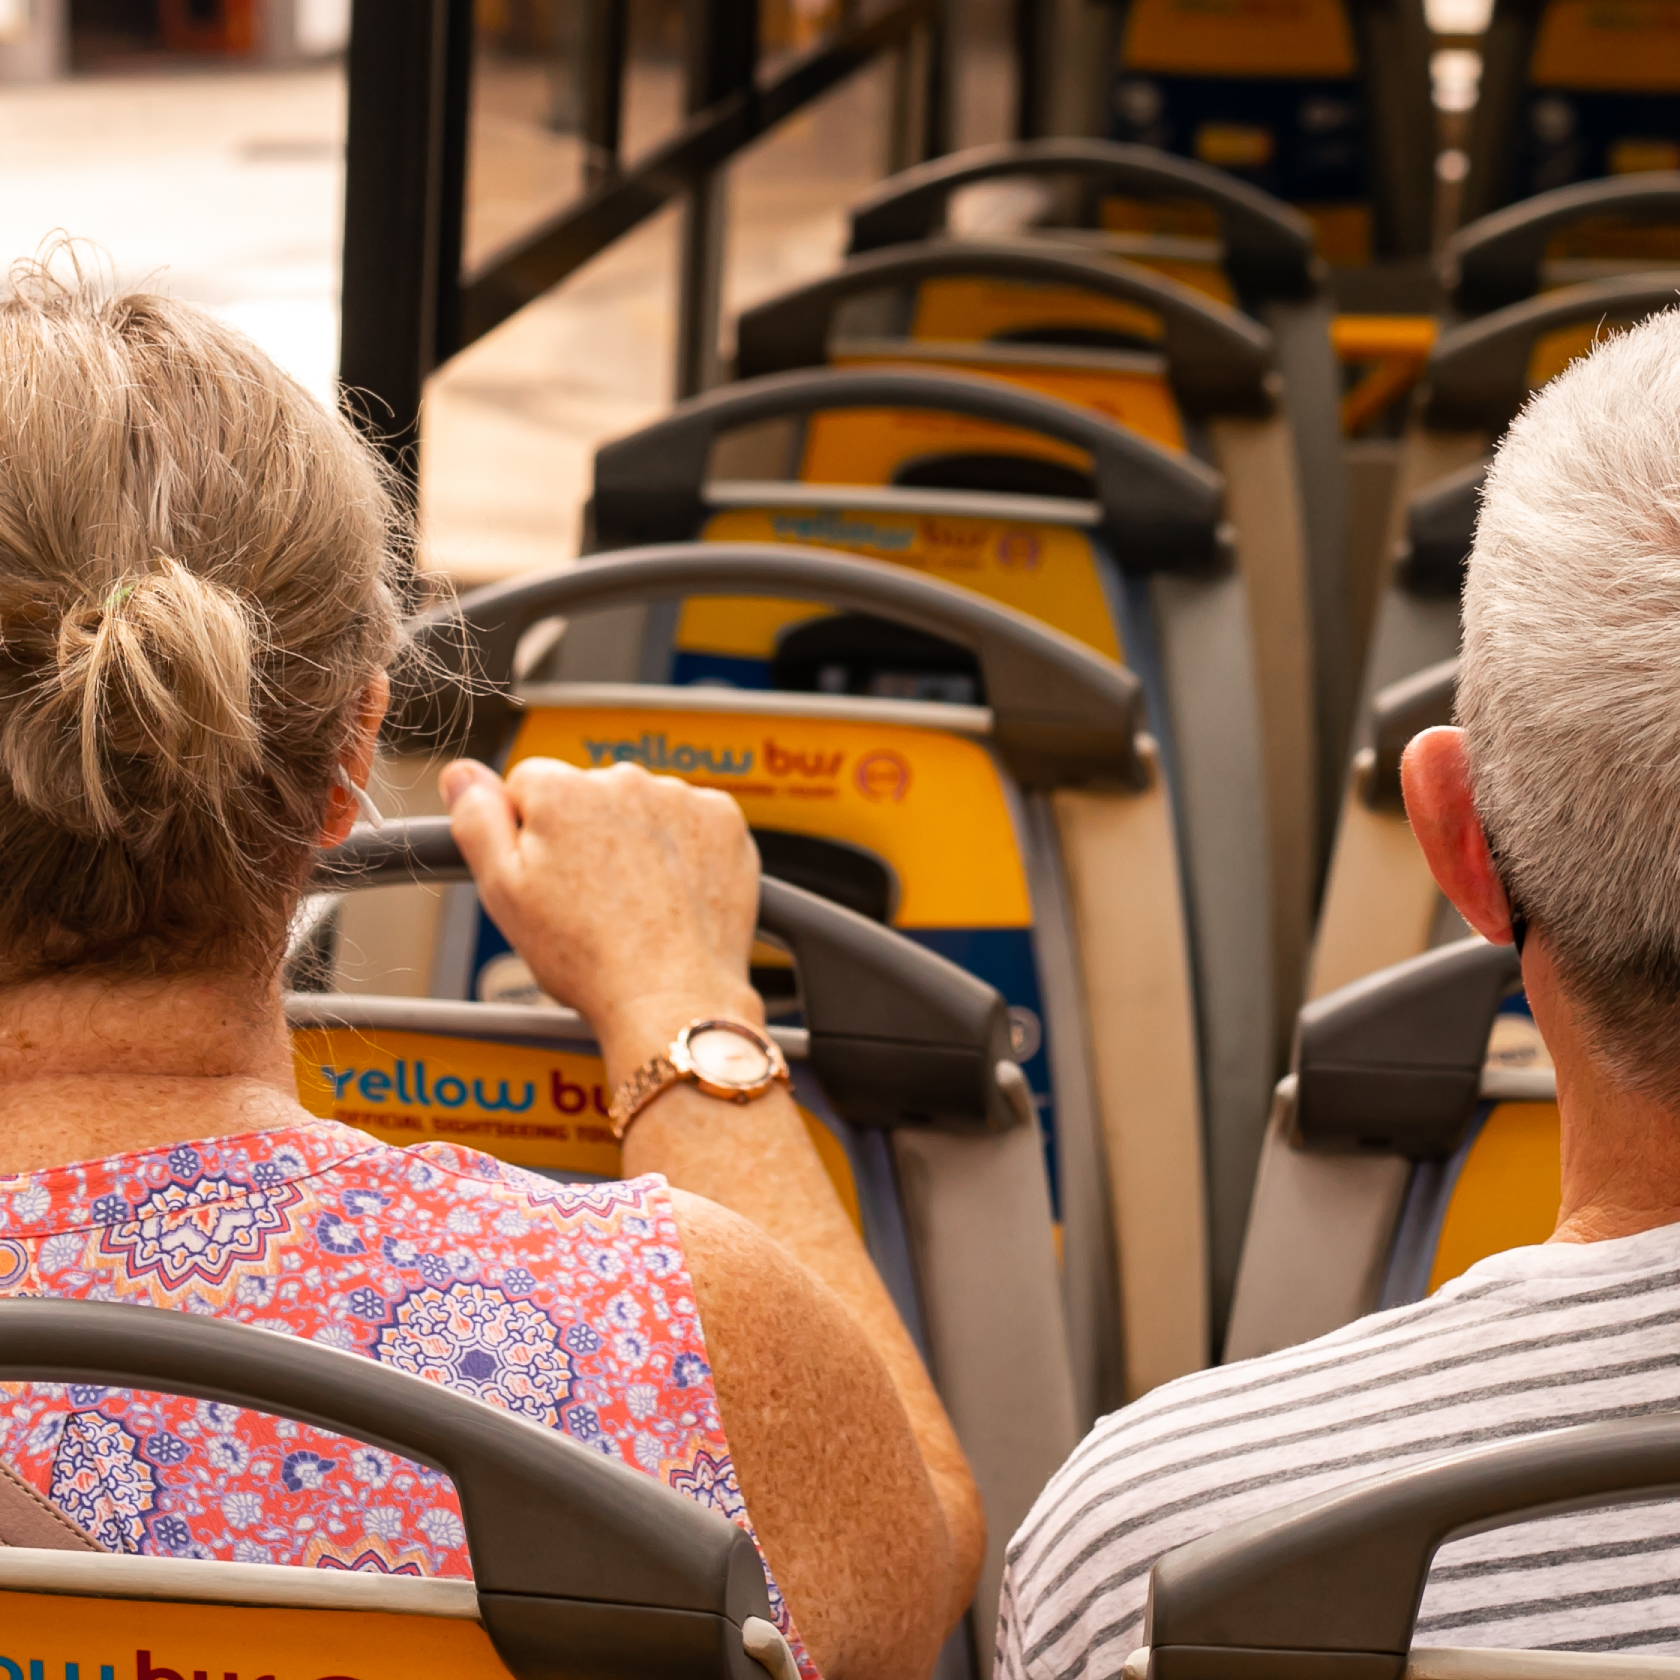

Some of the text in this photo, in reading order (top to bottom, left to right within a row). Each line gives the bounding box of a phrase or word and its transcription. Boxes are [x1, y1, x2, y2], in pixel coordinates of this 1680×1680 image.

[581, 731, 755, 777] yellow
[322, 1058, 613, 1115] yellow bu
